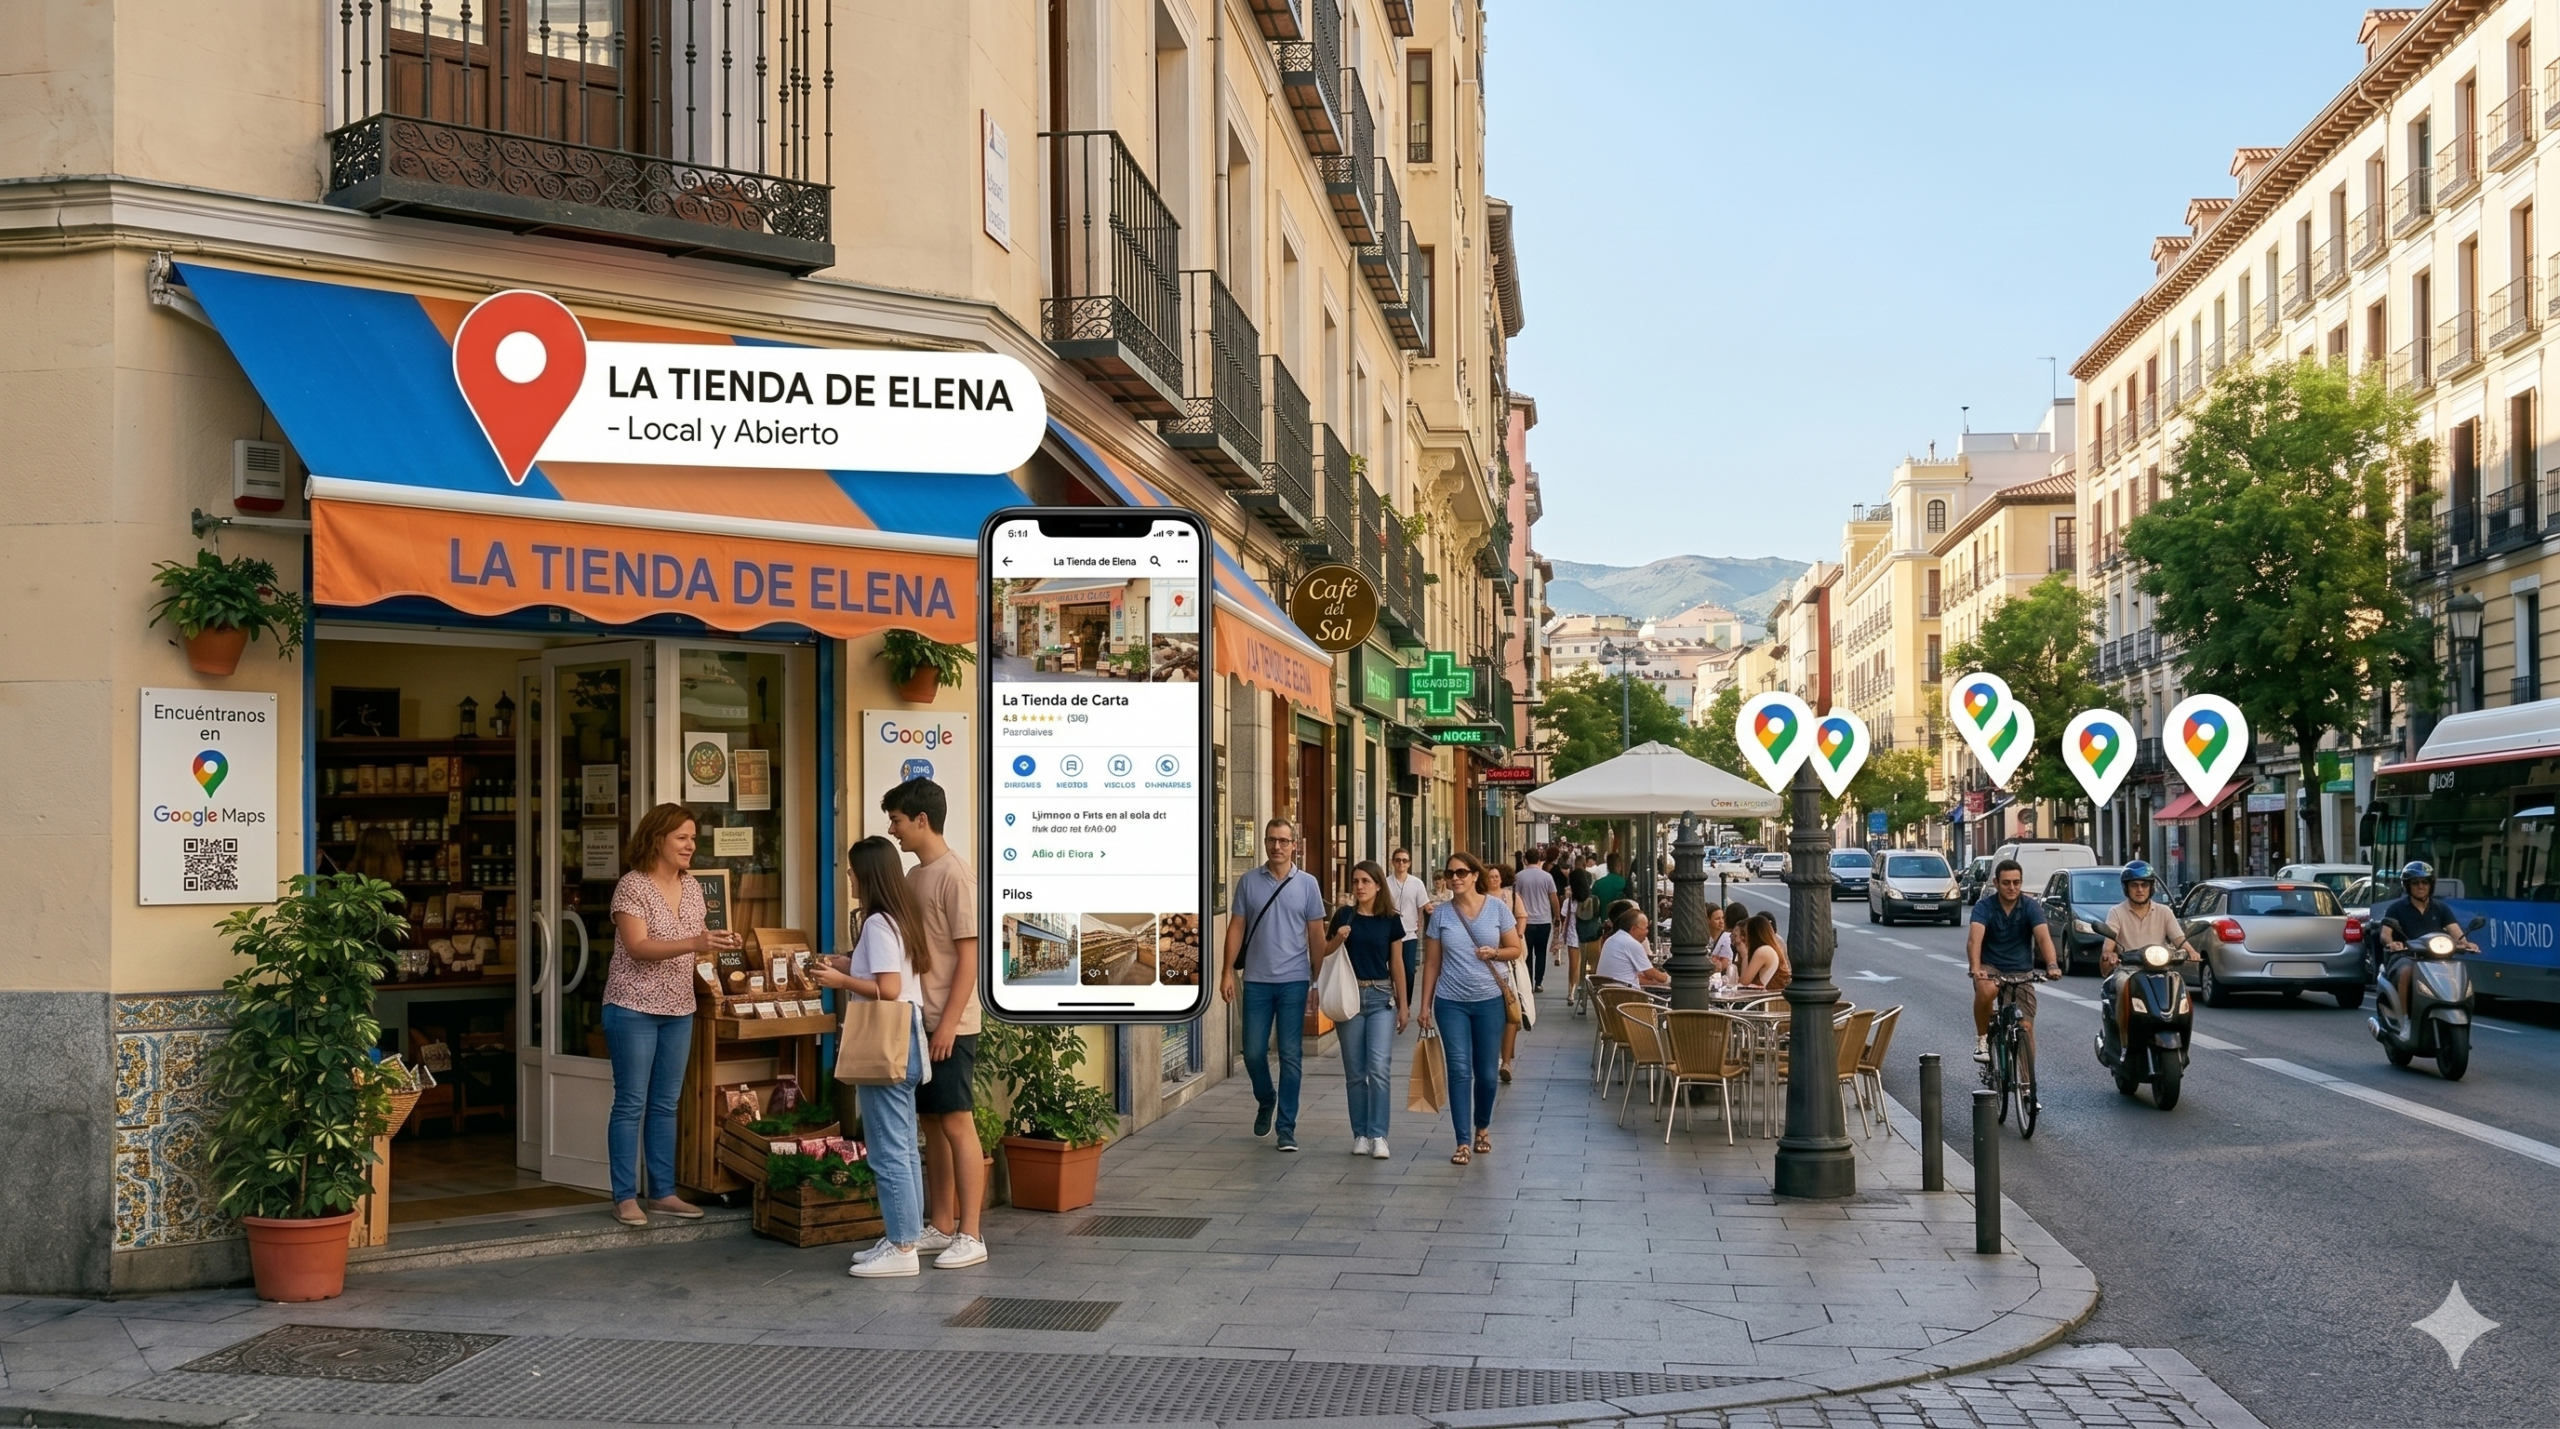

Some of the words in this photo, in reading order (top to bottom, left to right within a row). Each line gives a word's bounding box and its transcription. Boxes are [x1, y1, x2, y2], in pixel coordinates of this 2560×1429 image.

[1053, 557, 1065, 566] La
[1067, 556, 1097, 566] Tienda
[1098, 557, 1110, 566] de
[1112, 557, 1137, 566] Elena
[450, 537, 516, 588] LA
[532, 543, 719, 604] TIENDA
[733, 560, 795, 608] DE
[810, 566, 956, 620] ELENA
[1308, 578, 1358, 604] Café
[1324, 603, 1345, 616] del
[1316, 619, 1352, 641] Sol
[1002, 694, 1018, 706] La
[1021, 694, 1067, 706] Tienda
[1071, 694, 1088, 706] de
[1092, 694, 1129, 706] Carta
[154, 704, 265, 723] Encuéntranos
[1003, 714, 1018, 722] 4.8
[200, 729, 220, 741] en
[881, 721, 953, 751] Google
[153, 805, 218, 827] Google
[222, 807, 266, 827] Maps
[1002, 889, 1033, 900] Pilos
